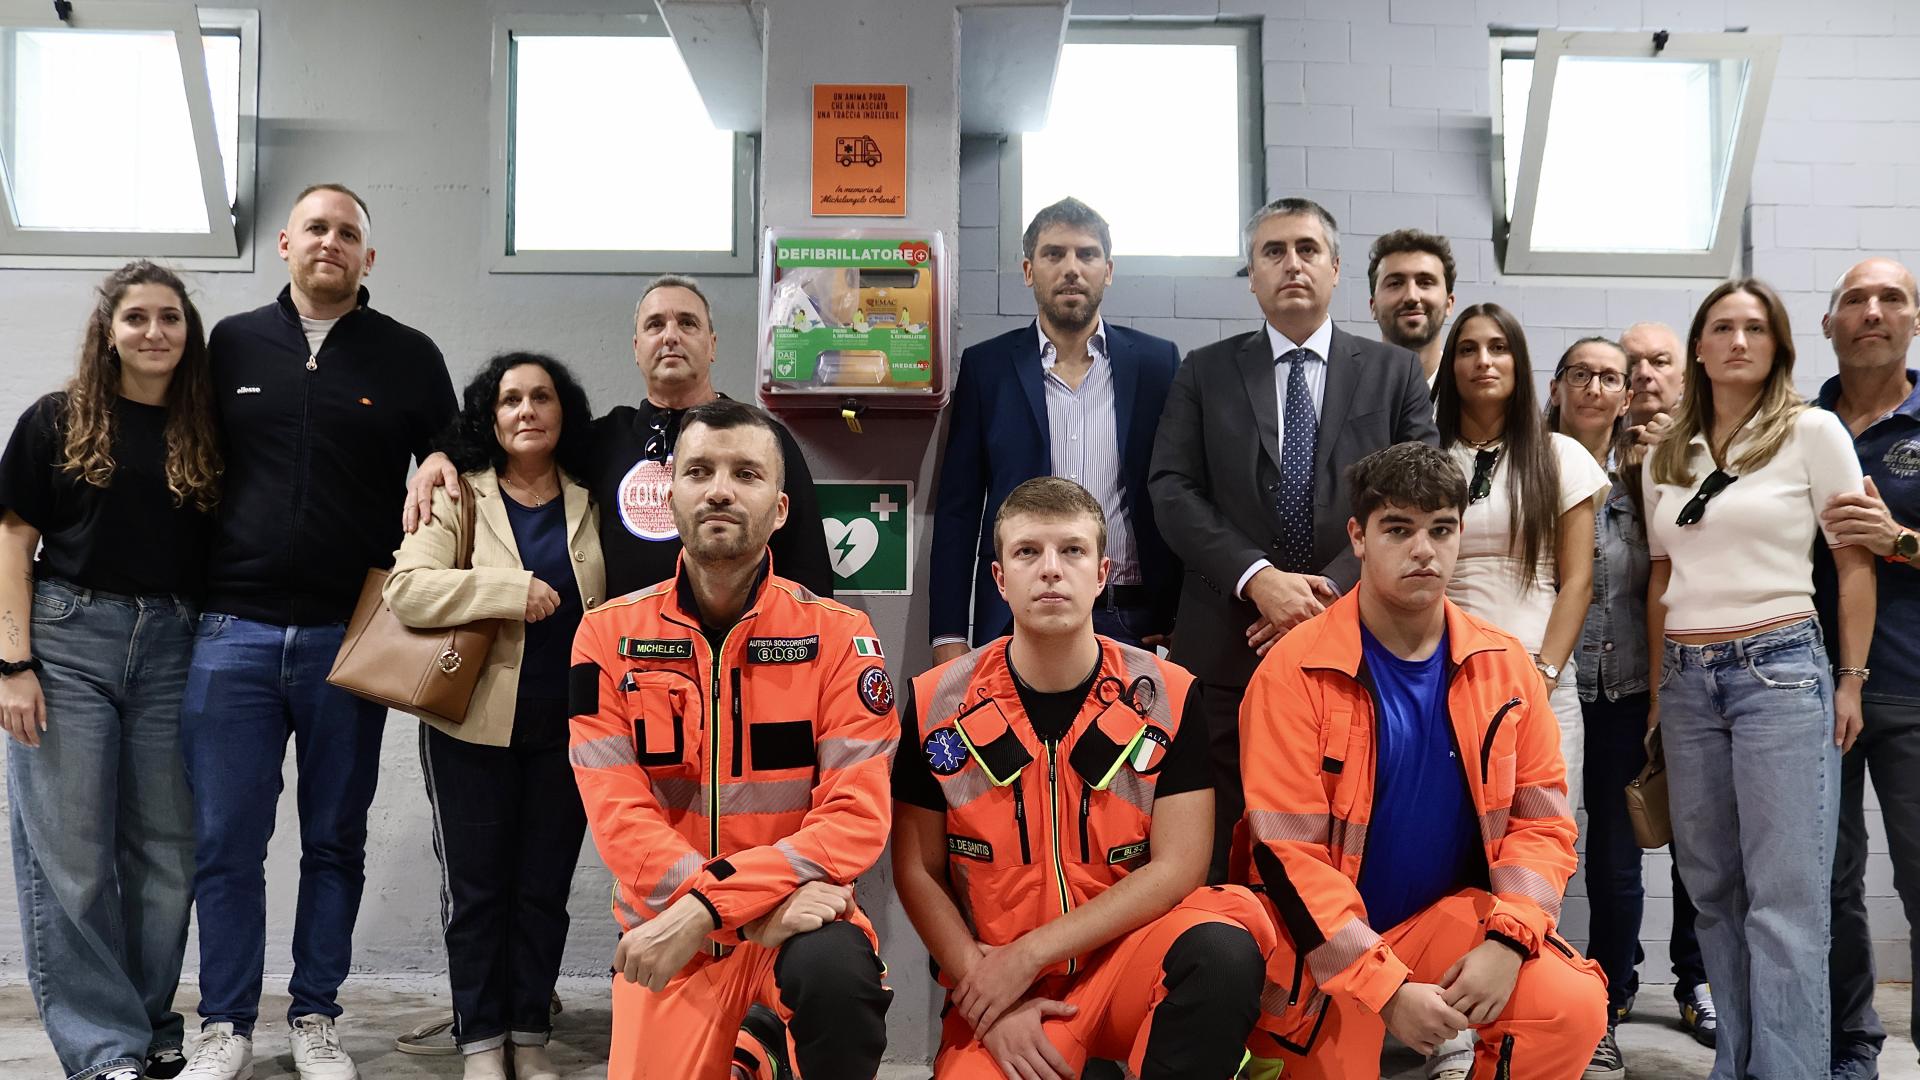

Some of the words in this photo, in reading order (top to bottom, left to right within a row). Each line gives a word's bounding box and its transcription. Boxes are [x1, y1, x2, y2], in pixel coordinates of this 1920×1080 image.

[868, 92, 886, 101] PURA
[831, 102, 843, 110] CHE
[846, 102, 855, 110] HA
[857, 102, 888, 110] LASCIATO
[817, 111, 831, 119] UNA
[833, 111, 861, 119] TRACCIA
[863, 111, 899, 119] INDELEBILE
[778, 248, 914, 261] DEFIBRILLATORE
[777, 351, 795, 359] DAE
[625, 482, 672, 507] COLM
[748, 639, 773, 648] AUTISTA
[773, 636, 818, 647] SOCCORRITORE
[636, 644, 675, 654] MICHELE
[676, 644, 685, 653] C.
[1143, 730, 1167, 746] TALIA
